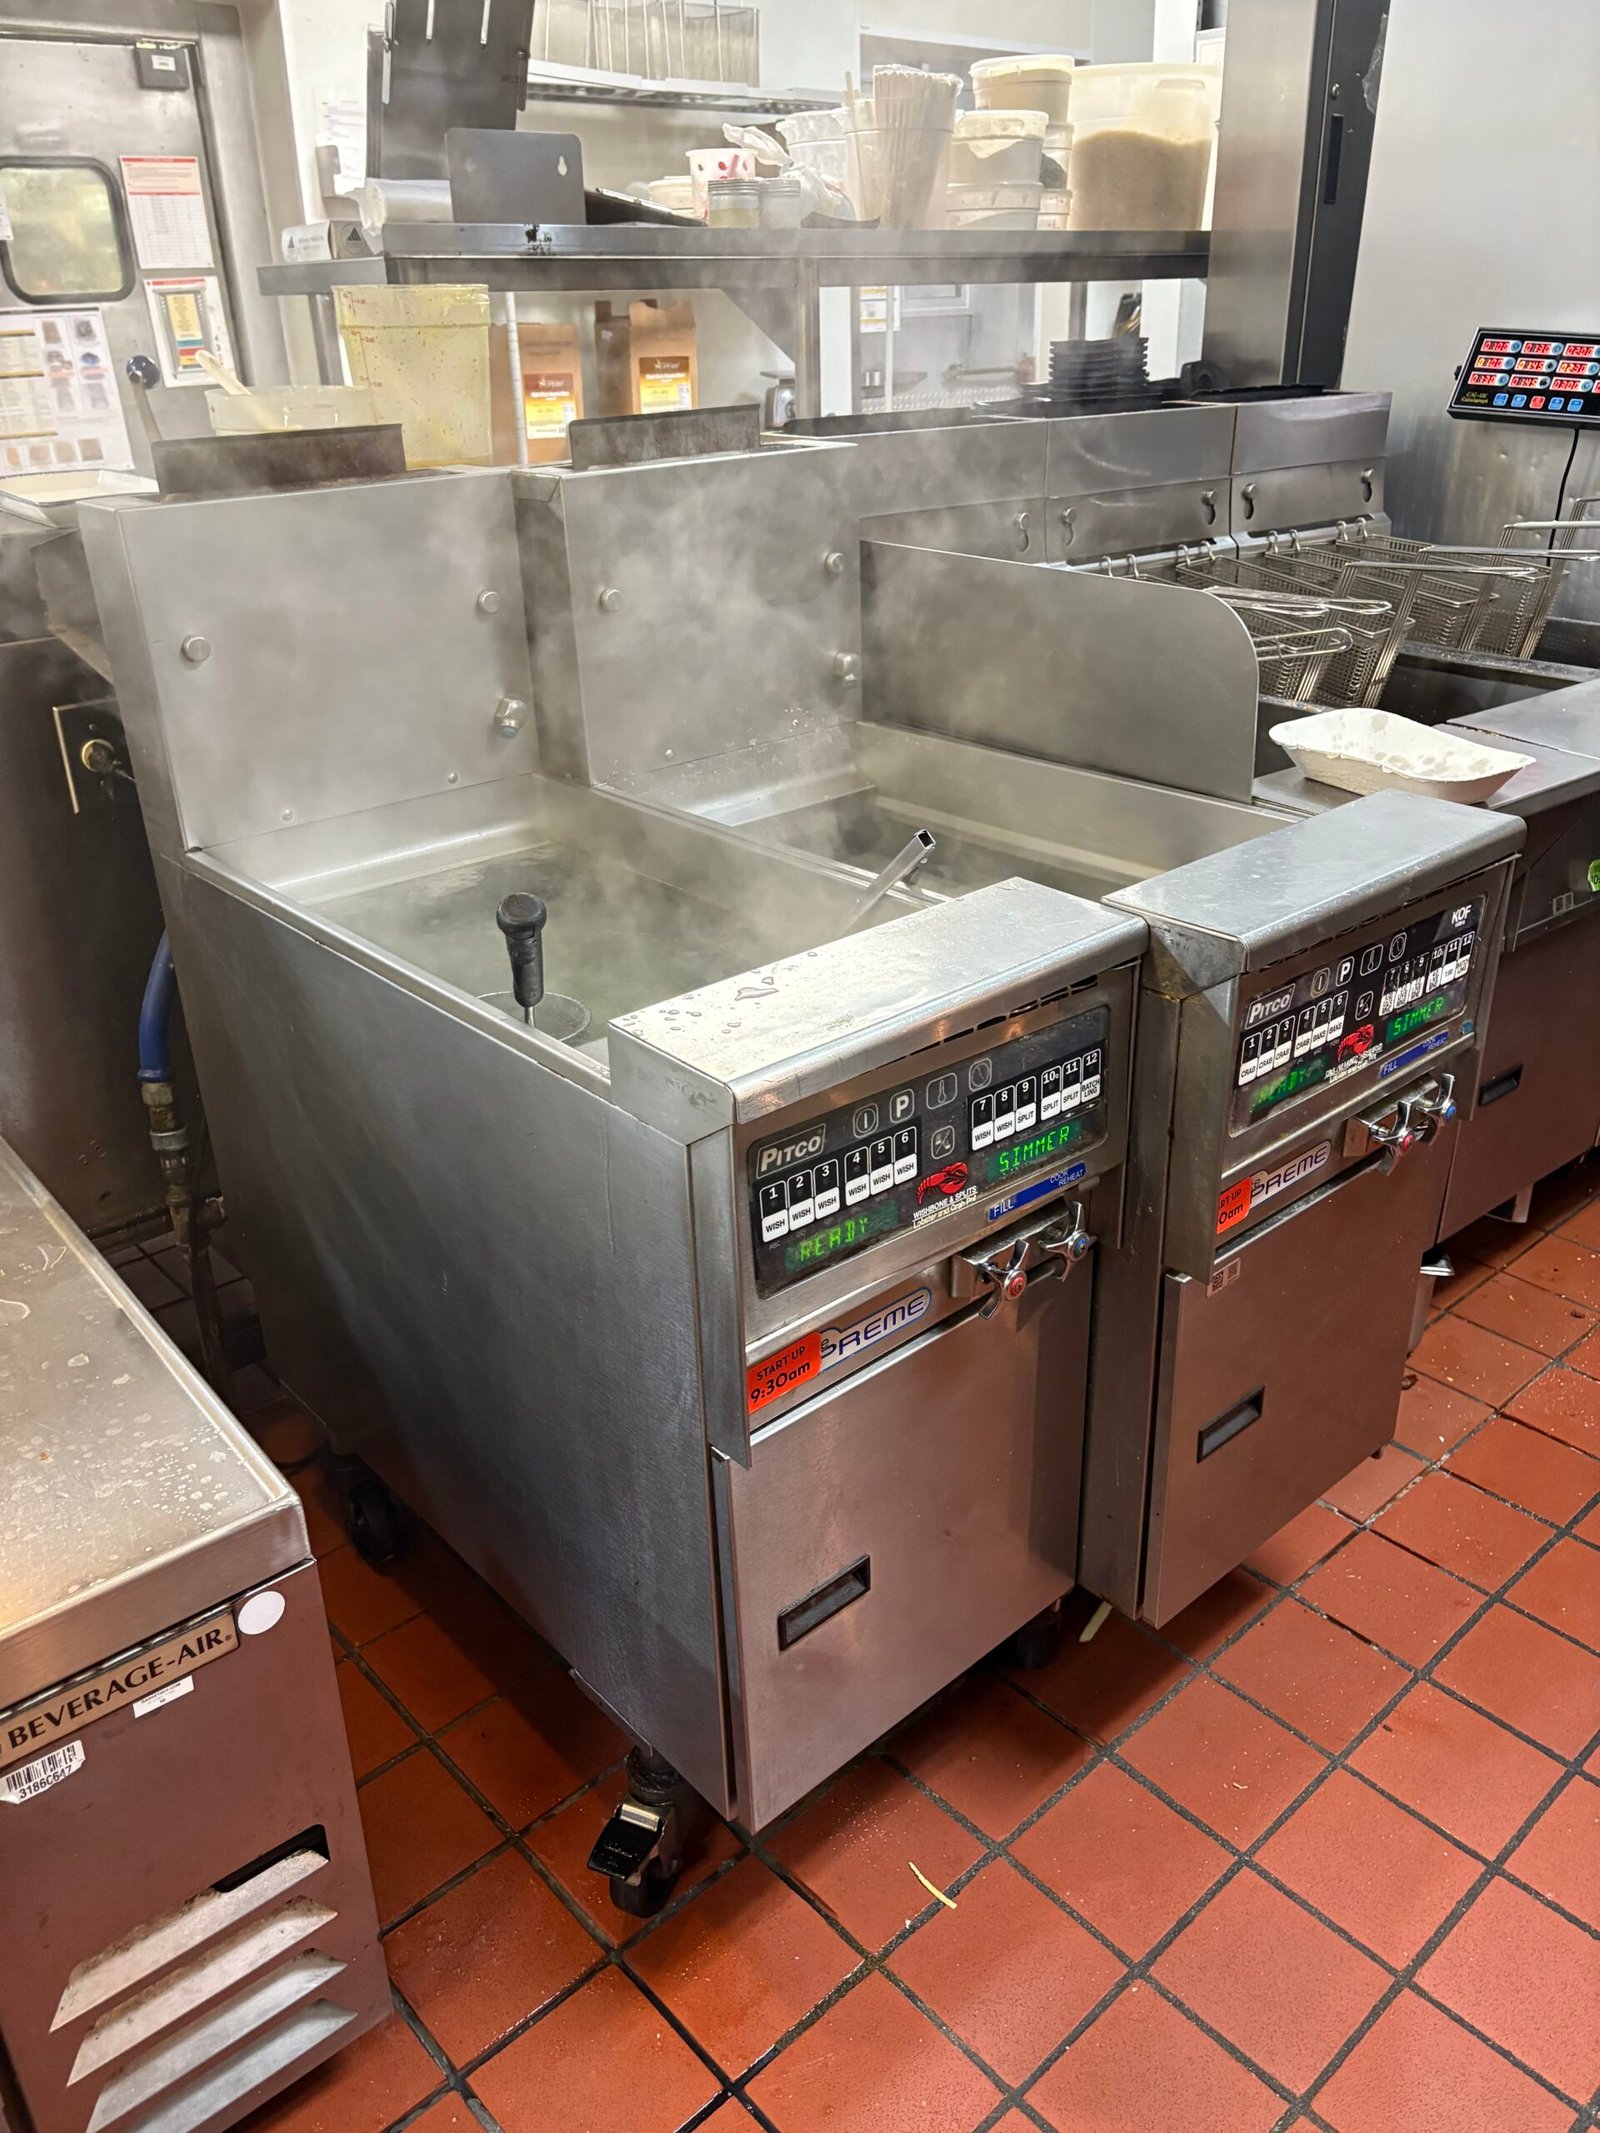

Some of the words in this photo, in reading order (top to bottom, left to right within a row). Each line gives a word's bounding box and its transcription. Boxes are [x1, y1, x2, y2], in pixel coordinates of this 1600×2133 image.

[1340, 962, 1351, 982] P
[979, 1099, 987, 1111] 7
[1001, 1090, 1008, 1102] 8
[1022, 1082, 1029, 1093] 9
[1065, 1061, 1079, 1075] 11
[1085, 1052, 1098, 1067] 12
[1383, 1061, 1398, 1075] FILL
[896, 1095, 909, 1118] P
[975, 1128, 991, 1142] WISH
[996, 1119, 1013, 1133] WISH
[1017, 1110, 1034, 1124] SPLIT
[1042, 1099, 1059, 1113] SPLIT
[1063, 1090, 1079, 1104] SPLIT
[761, 1134, 821, 1172] PITCO
[769, 1187, 778, 1200] 1
[796, 1176, 804, 1188] 2
[822, 1165, 830, 1177] 3
[852, 1152, 860, 1164] 4
[877, 1142, 885, 1153] 5
[901, 1132, 909, 1144] 6
[1000, 1125, 1070, 1174] SIMMER
[1050, 1169, 1069, 1184] COOK
[1058, 1168, 1084, 1186] REHEAT
[765, 1218, 785, 1233] WISH
[791, 1206, 811, 1221] WISH
[817, 1195, 837, 1210] WISH
[848, 1183, 867, 1197] WISH
[873, 1172, 891, 1187] WISH
[897, 1162, 915, 1176] WISH
[993, 1199, 1014, 1217] FILL
[800, 1216, 868, 1262] READY
[756, 1355, 790, 1380] START
[792, 1345, 806, 1361] UP
[750, 1361, 811, 1404] 9:30am
